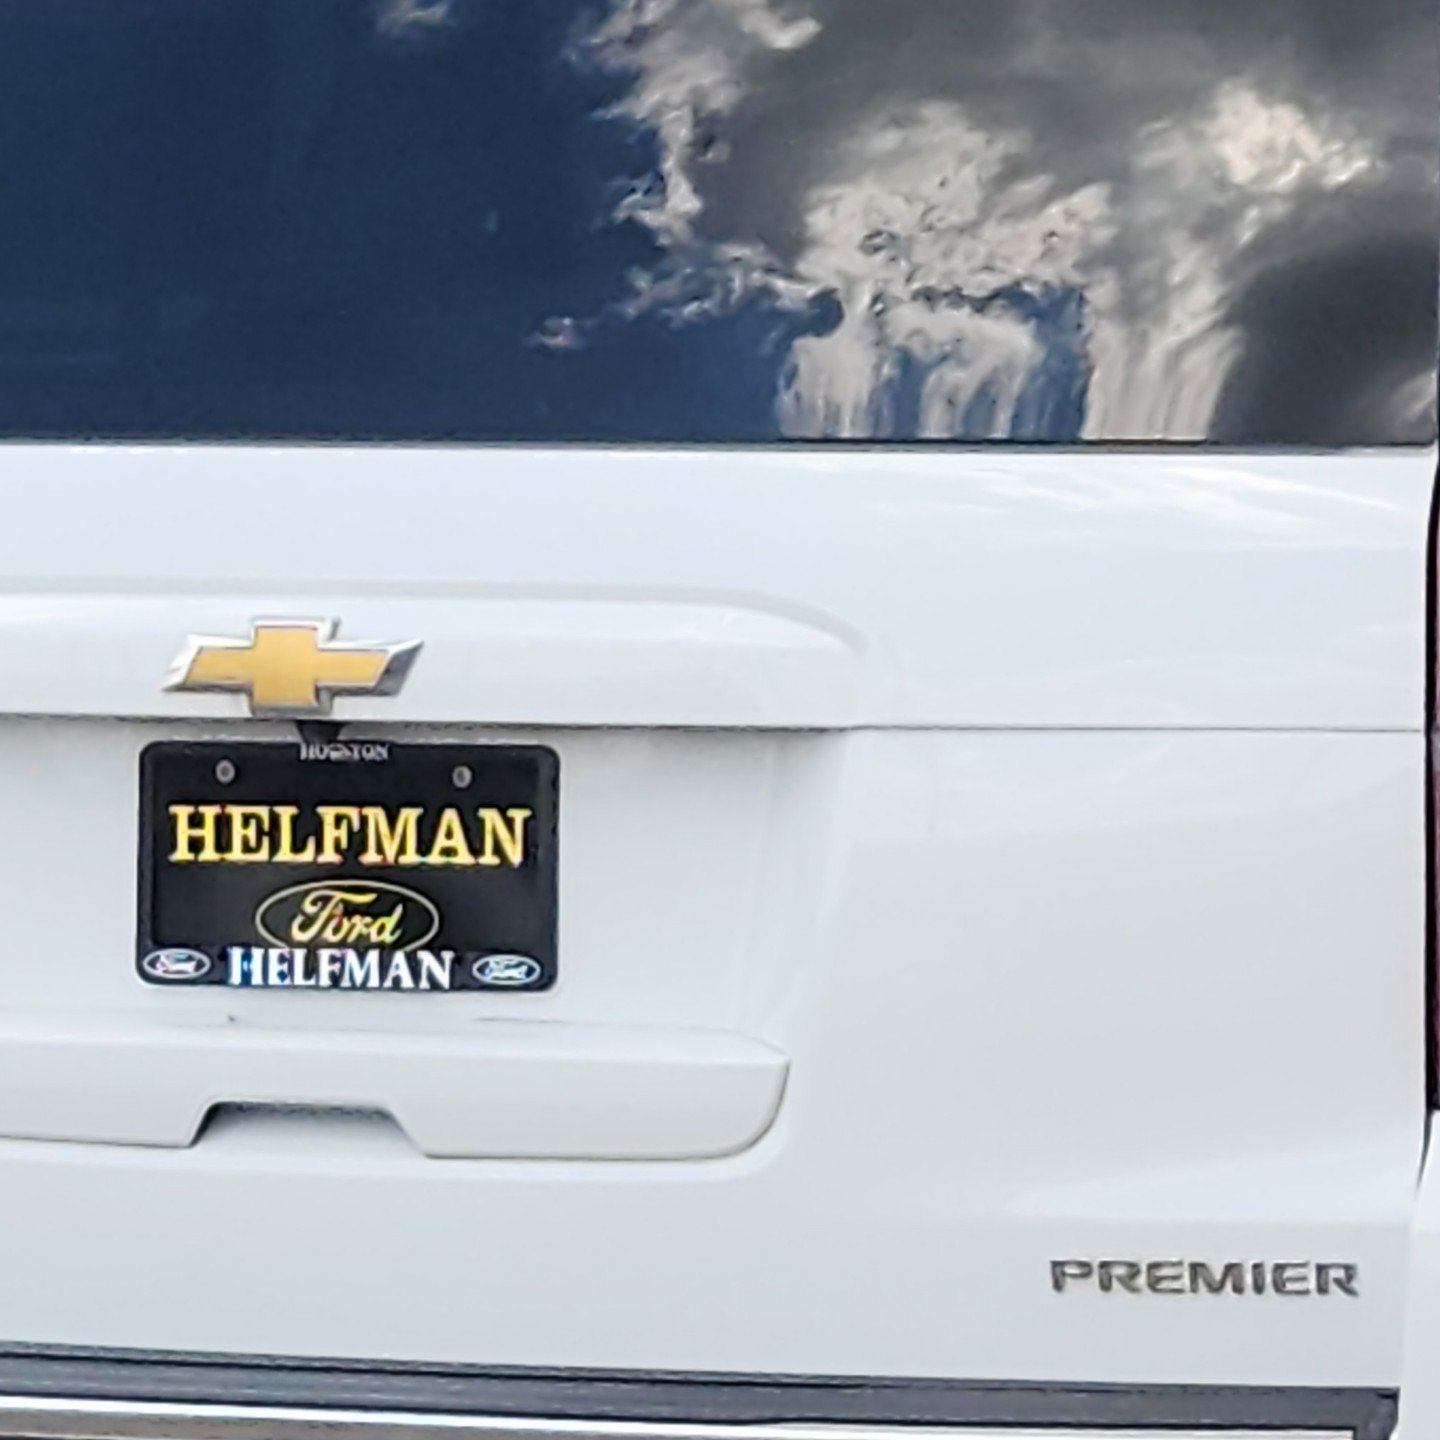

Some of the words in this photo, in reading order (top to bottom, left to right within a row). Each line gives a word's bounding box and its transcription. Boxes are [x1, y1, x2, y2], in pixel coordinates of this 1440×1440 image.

[168, 803, 533, 869] HELFMAN
[290, 887, 405, 947] Ford
[227, 946, 455, 990] HELFMAN
[1049, 1259, 1360, 1298] PREMIER
